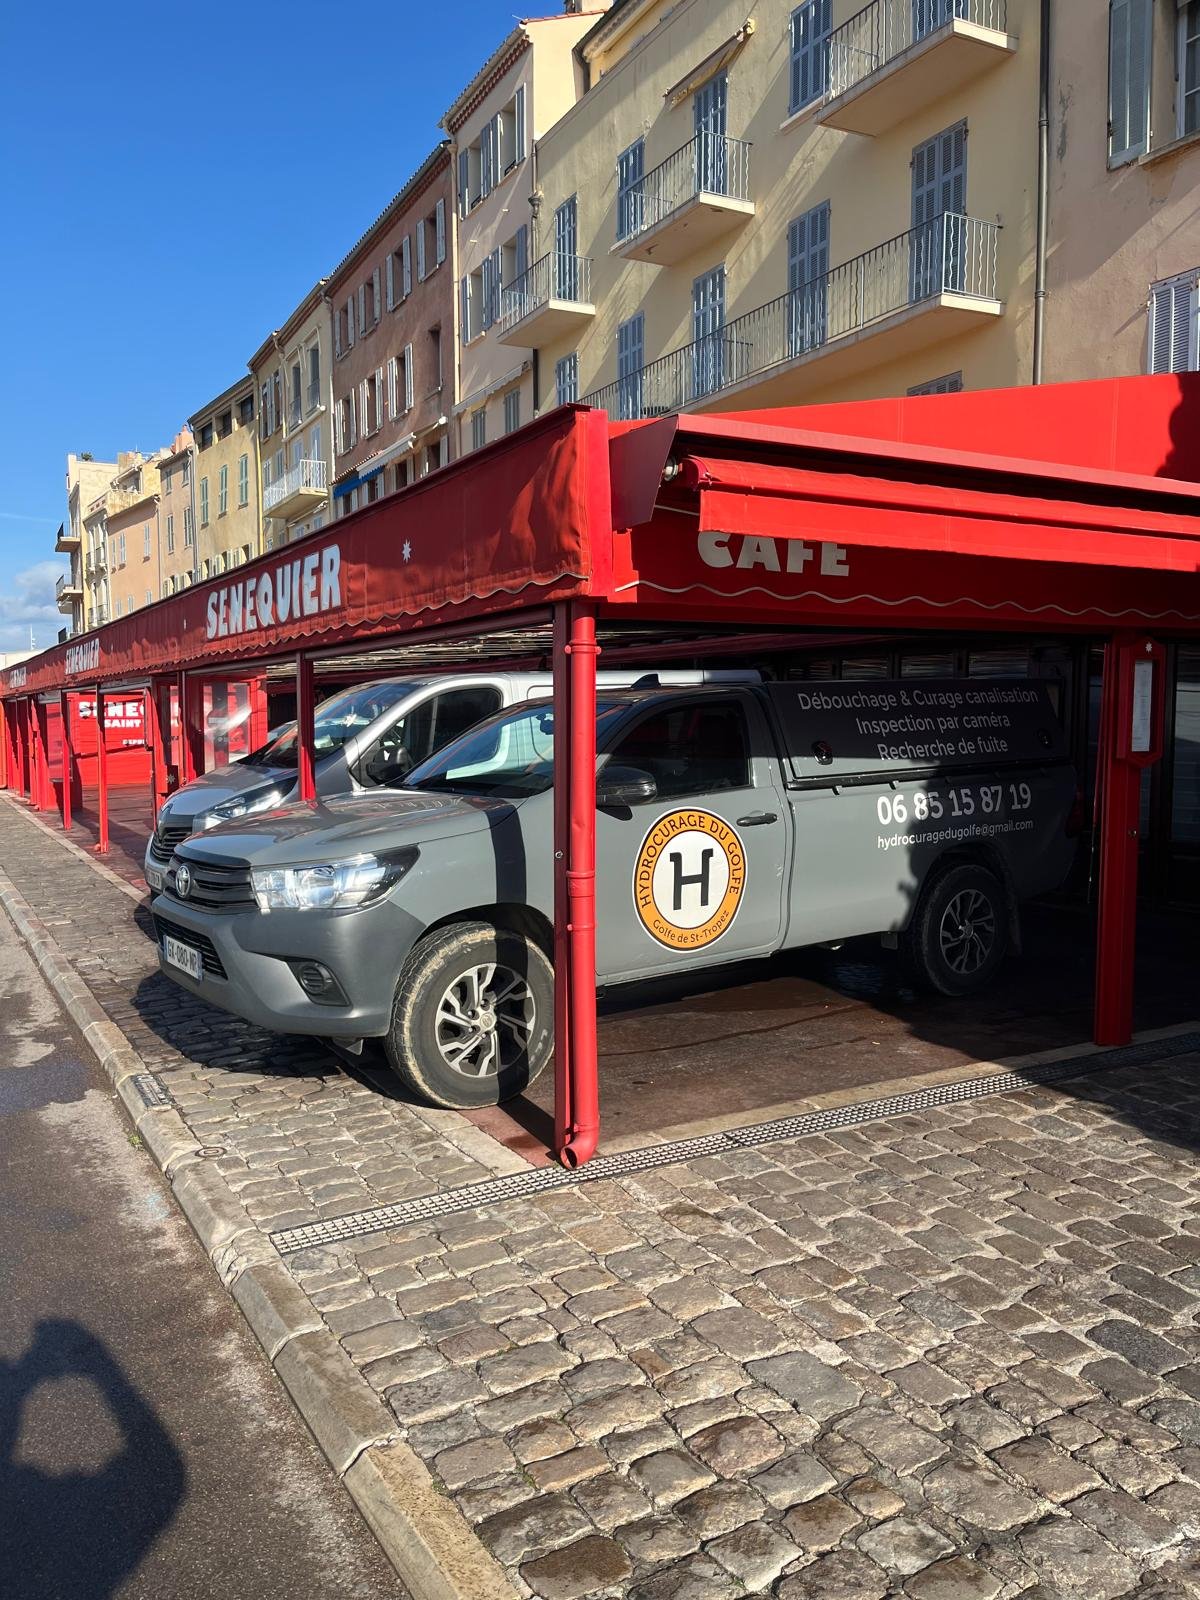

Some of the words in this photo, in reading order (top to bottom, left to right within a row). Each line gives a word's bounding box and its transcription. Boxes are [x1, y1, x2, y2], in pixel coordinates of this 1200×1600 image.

[206, 543, 342, 640] SENEQUIER
[797, 690, 898, 711] Débouchage
[900, 690, 912, 706] &
[913, 689, 963, 708] Curage
[965, 687, 1039, 704] canalisation
[855, 714, 936, 737] Inspection
[937, 715, 959, 733] par
[962, 711, 1011, 730] caméra
[877, 738, 956, 760] Recherche
[958, 737, 976, 754] de
[977, 735, 1009, 753] fuite
[877, 795, 907, 825] 06
[913, 791, 944, 820] 85
[948, 788, 975, 817] 15
[979, 785, 1003, 813] 87
[1009, 783, 1032, 810] 19
[877, 819, 1034, 850] hydrocuragedugolfe@gmail.com
[639, 814, 705, 908] HYDROCURAGE
[709, 820, 729, 841] DU
[727, 842, 742, 895] GOLFE
[669, 848, 714, 911] H
[653, 919, 676, 941] Golfe
[677, 934, 689, 944] de
[690, 910, 730, 943] St-Tropez
